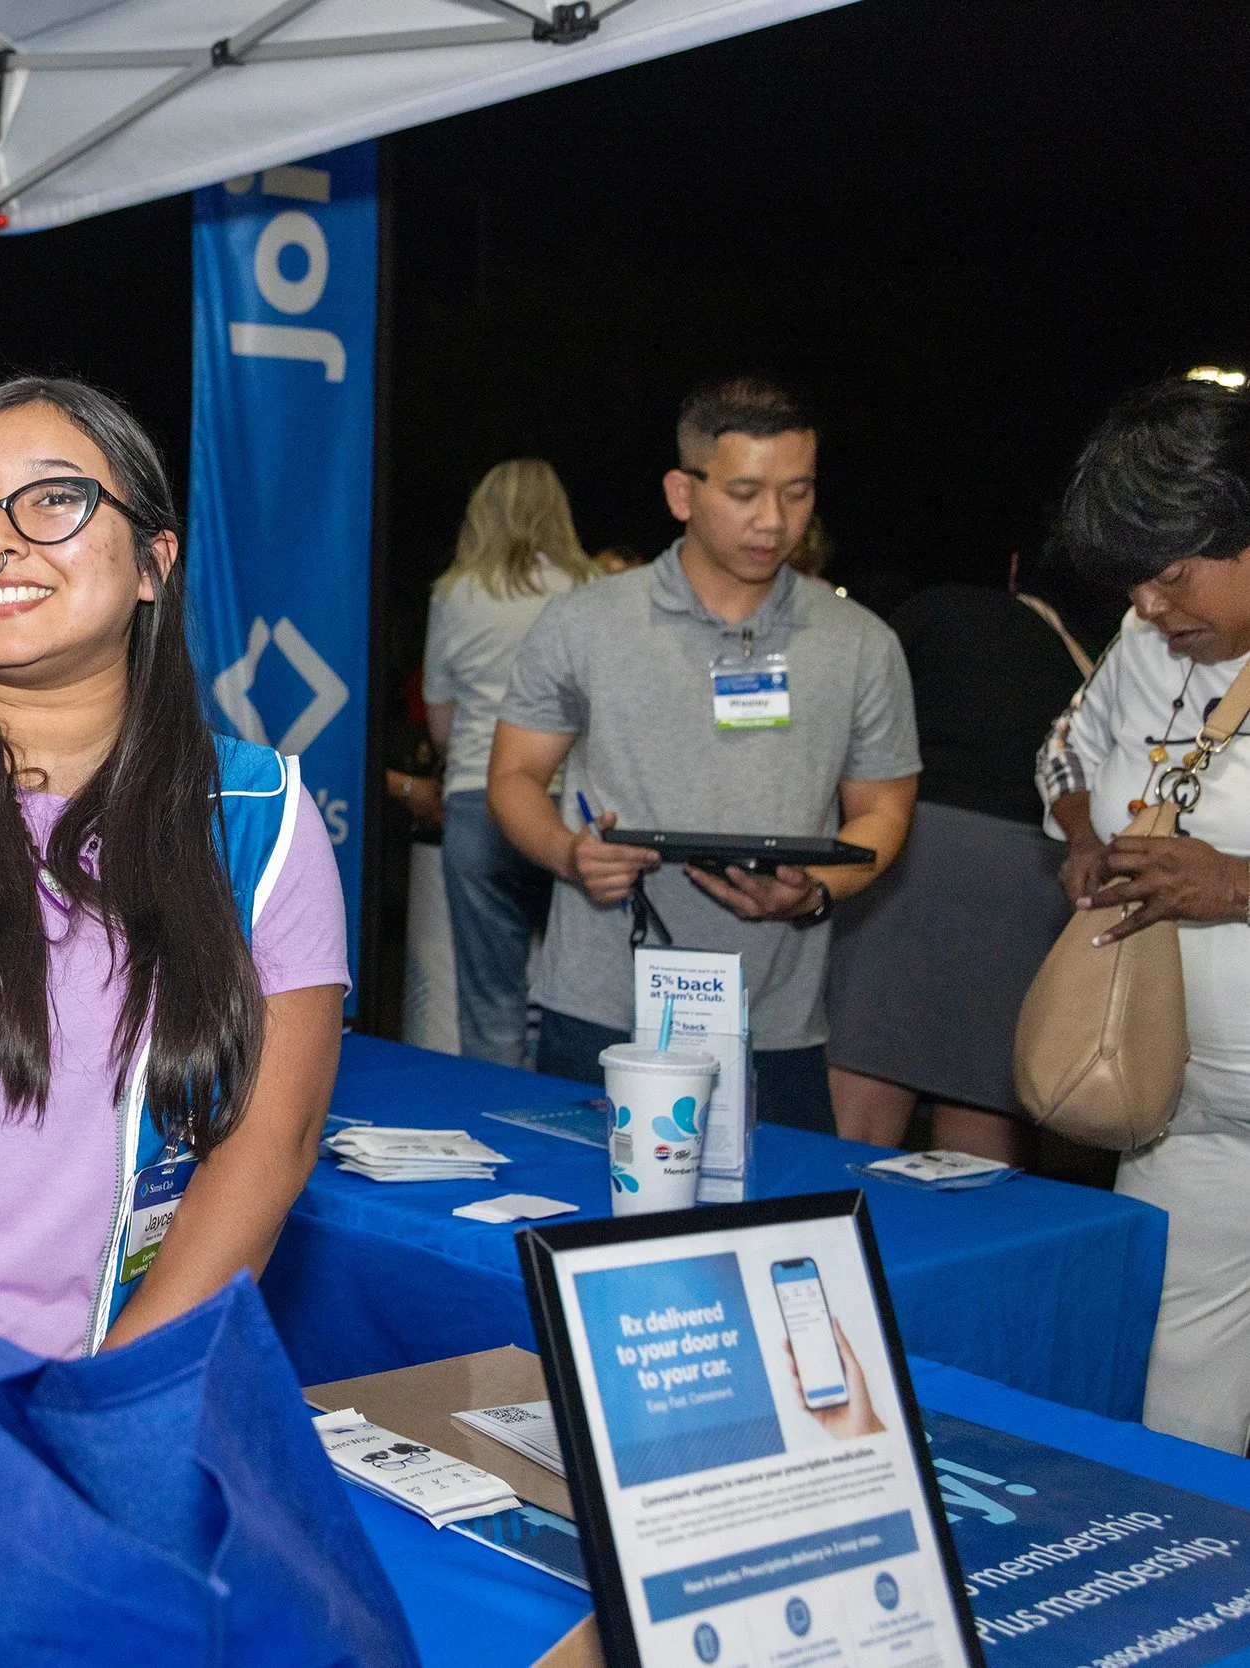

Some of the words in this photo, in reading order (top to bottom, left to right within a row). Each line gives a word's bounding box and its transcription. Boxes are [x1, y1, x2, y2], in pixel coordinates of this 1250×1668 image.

[650, 974, 674, 989] 5%
[678, 976, 725, 992] back
[650, 991, 661, 999] at
[663, 991, 694, 1001] Sam's
[696, 992, 726, 1003] Club.
[145, 1211, 173, 1232] Jayce
[620, 1314, 645, 1338] Rx
[645, 1300, 725, 1334] delivered
[616, 1345, 638, 1366] to
[637, 1339, 678, 1368] your
[680, 1331, 719, 1355] door
[721, 1329, 739, 1347] or
[637, 1369, 659, 1390] to
[660, 1363, 699, 1391] your
[701, 1358, 732, 1379] car.
[968, 1511, 1174, 1588] membership.
[1034, 1535, 1241, 1618] membership.
[1177, 1611, 1225, 1632] for
